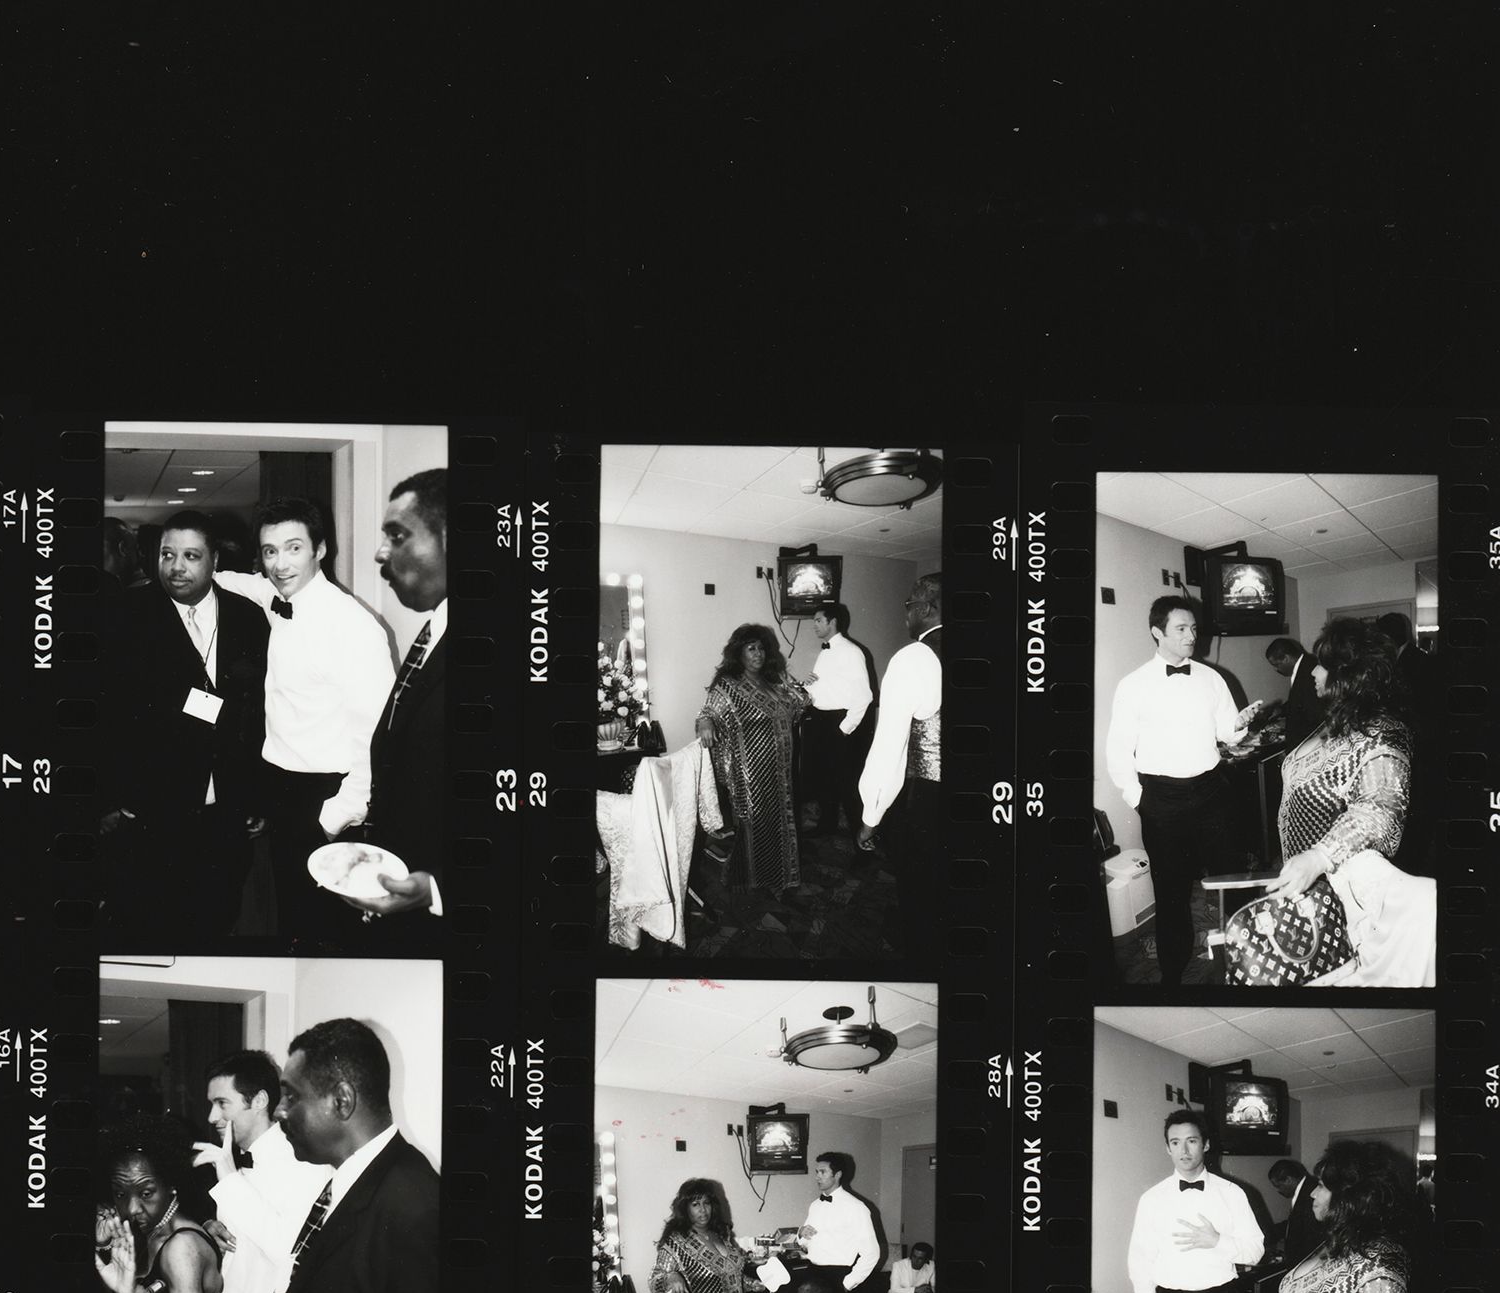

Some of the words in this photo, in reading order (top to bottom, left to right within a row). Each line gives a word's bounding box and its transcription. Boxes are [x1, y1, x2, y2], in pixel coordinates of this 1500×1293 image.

[3, 490, 16, 528] 17A
[37, 488, 54, 558] 400TX
[497, 504, 510, 547] 23A
[532, 502, 549, 571] 400TX
[993, 517, 1006, 560] 29A
[1029, 512, 1045, 582] 400TX
[35, 575, 52, 668] KODAK
[530, 589, 548, 681] KODAK
[1027, 599, 1045, 692] KODAK
[3, 754, 22, 788] 17
[496, 769, 516, 811] 23
[529, 772, 546, 807] 29
[992, 782, 1013, 824] 29
[491, 1045, 504, 1087] 22A
[988, 1055, 1001, 1097] 28A
[1486, 1065, 1499, 1108] 34A
